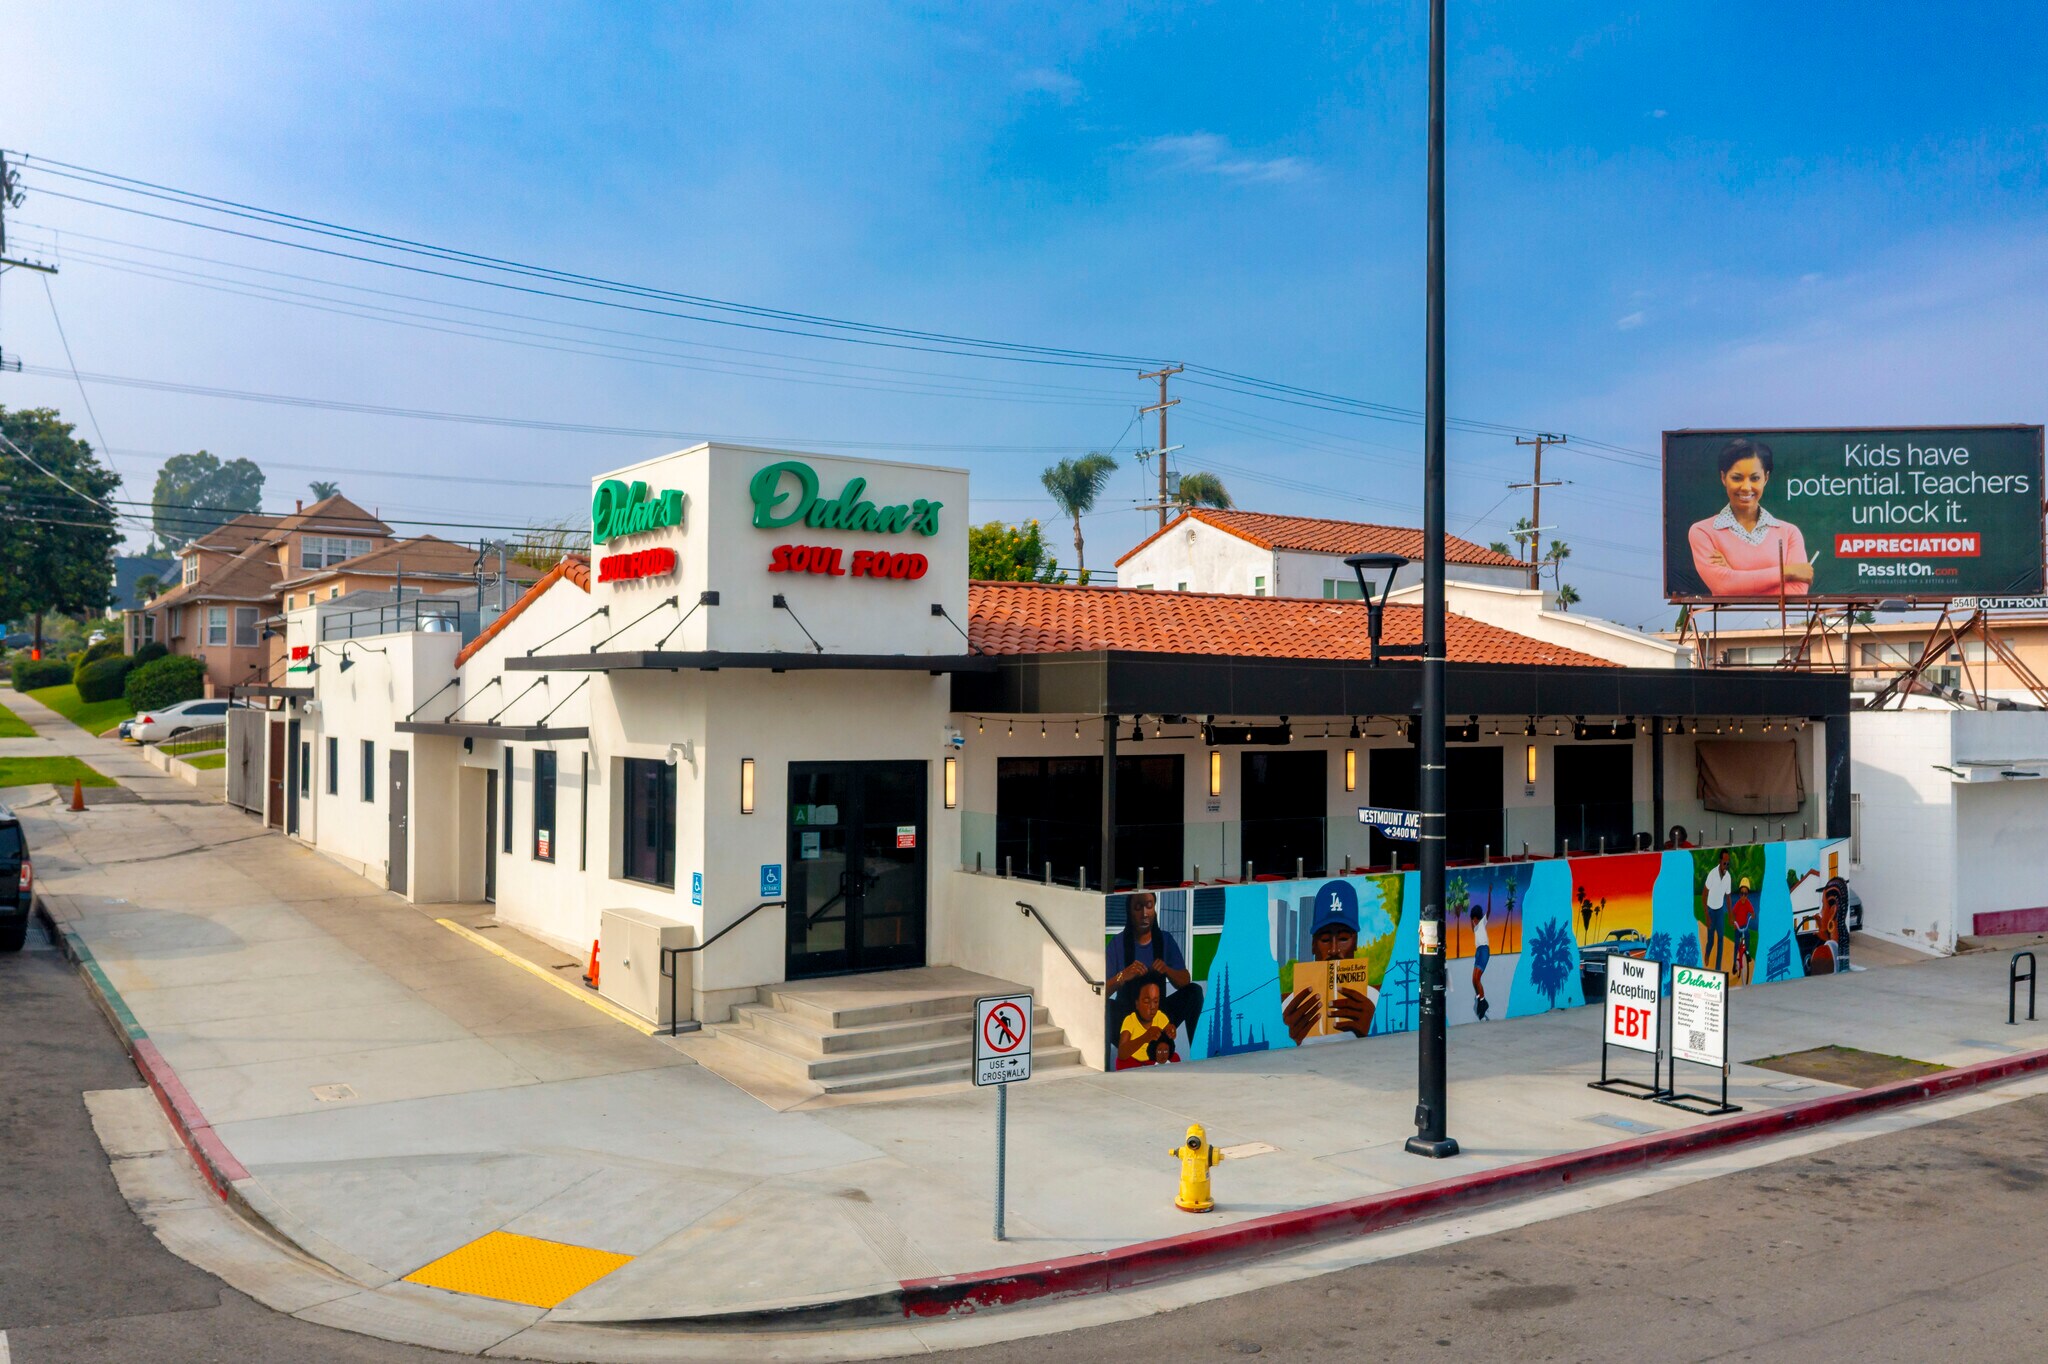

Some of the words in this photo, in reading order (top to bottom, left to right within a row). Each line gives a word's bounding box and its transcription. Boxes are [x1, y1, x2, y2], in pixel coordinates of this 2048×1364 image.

[1845, 443, 1900, 467] Kids
[1908, 443, 1969, 466] have
[1787, 472, 1905, 501] potential.
[1908, 471, 2029, 495] Teachers
[749, 461, 944, 537] Dulan's
[592, 479, 684, 546] Dulan's
[1852, 500, 1939, 523] unlock
[1946, 500, 1968, 523] it.
[1839, 537, 1975, 553] APPRECIATION
[598, 553, 631, 583] SOUL
[631, 547, 676, 580] FOOD
[768, 544, 845, 576] SOUL
[851, 550, 928, 580] FOOD
[1858, 562, 1958, 577] PassItOn.com
[1953, 598, 1976, 608] 5540
[796, 809, 806, 821] A
[1359, 808, 1403, 826] WESTMOUNT
[1391, 826, 1410, 839] 3400
[1410, 828, 1418, 840] W.
[1337, 971, 1366, 983] KINDRED
[1622, 961, 1645, 979] Now
[1677, 970, 1721, 990] Dulan's
[1610, 979, 1656, 1004] Accepting
[1614, 1004, 1651, 1040] EBT
[990, 1060, 1005, 1069] USE
[982, 1068, 1025, 1081] CROSSWALK
